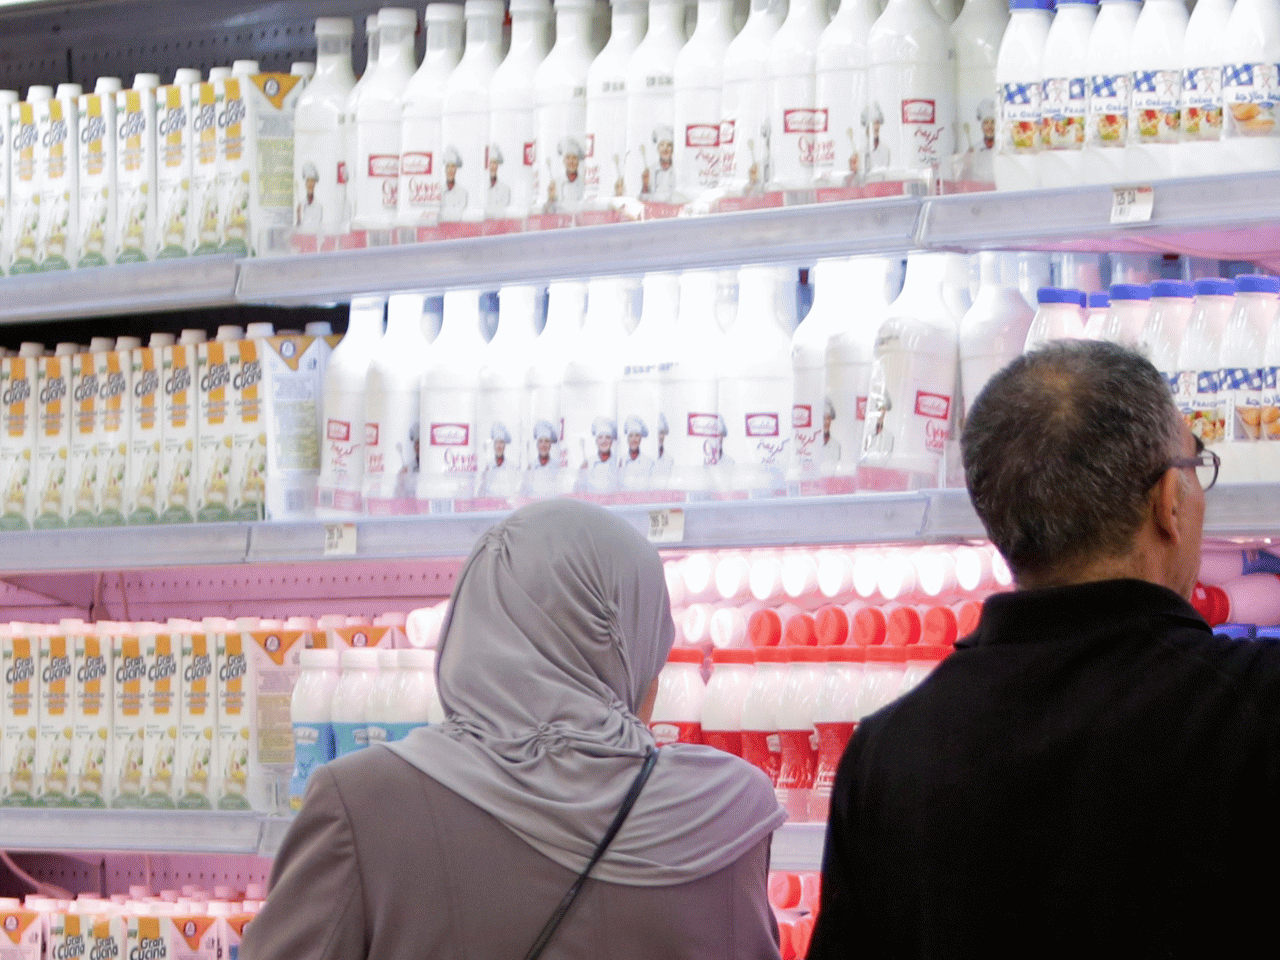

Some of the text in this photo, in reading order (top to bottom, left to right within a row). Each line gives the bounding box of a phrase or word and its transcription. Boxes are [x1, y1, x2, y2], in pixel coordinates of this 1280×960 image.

[51, 656, 69, 668] Gran
[86, 655, 104, 668] Gran
[124, 655, 144, 668] Gran
[157, 653, 174, 666] Gran
[193, 654, 210, 666] Gran
[228, 653, 245, 665] Gran
[66, 935, 83, 946] Gran
[96, 936, 114, 947] Gran
[141, 937, 163, 949] Gran
[58, 942, 85, 960] Cucina
